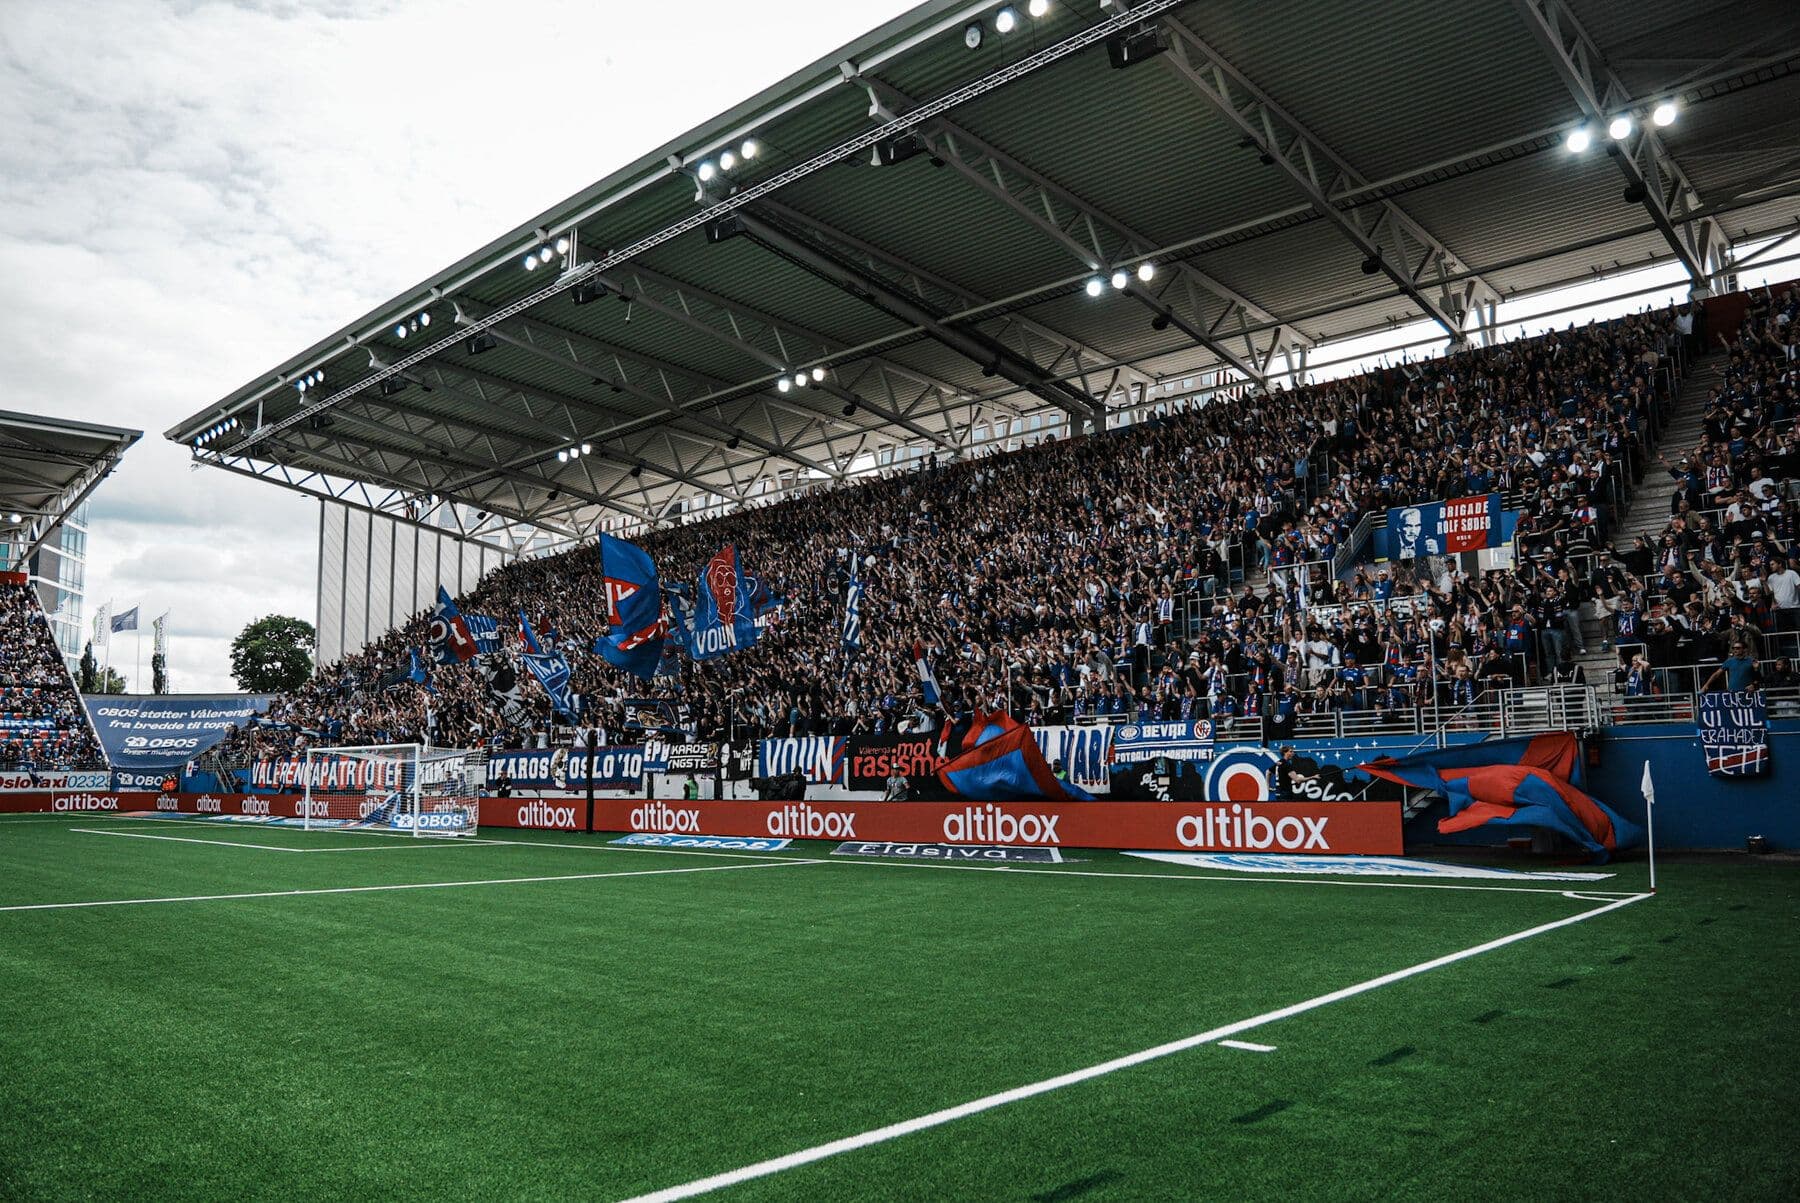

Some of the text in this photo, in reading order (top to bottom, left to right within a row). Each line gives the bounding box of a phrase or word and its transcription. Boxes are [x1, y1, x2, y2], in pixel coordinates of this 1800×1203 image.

[1440, 501, 1489, 519] BRIGADE
[1437, 519, 1459, 535] ROLF
[696, 623, 737, 655] VOLIN
[1700, 692, 1720, 708] DET
[97, 707, 139, 718] OBOS
[140, 709, 188, 719] støtter
[109, 719, 235, 731] fra bredde til topp
[1142, 723, 1187, 740] BEVAR
[149, 738, 199, 749] OBOS
[897, 738, 932, 757] mot
[488, 752, 643, 781] IKAROS OSLO '10
[766, 735, 835, 782] VOLIN
[853, 749, 950, 778] rasisme
[1704, 744, 1768, 775] FETT
[135, 775, 165, 786] OBO
[55, 794, 119, 810] altibox
[157, 794, 179, 811] altibox
[196, 793, 222, 813] altibox
[241, 795, 270, 815] altibox
[295, 797, 330, 817] albox
[418, 814, 463, 828] OBOS
[517, 799, 577, 828] altibox
[630, 801, 701, 833] altibox
[766, 802, 857, 838] altibox
[943, 803, 1061, 844] altibox
[1175, 803, 1330, 850] altibox
